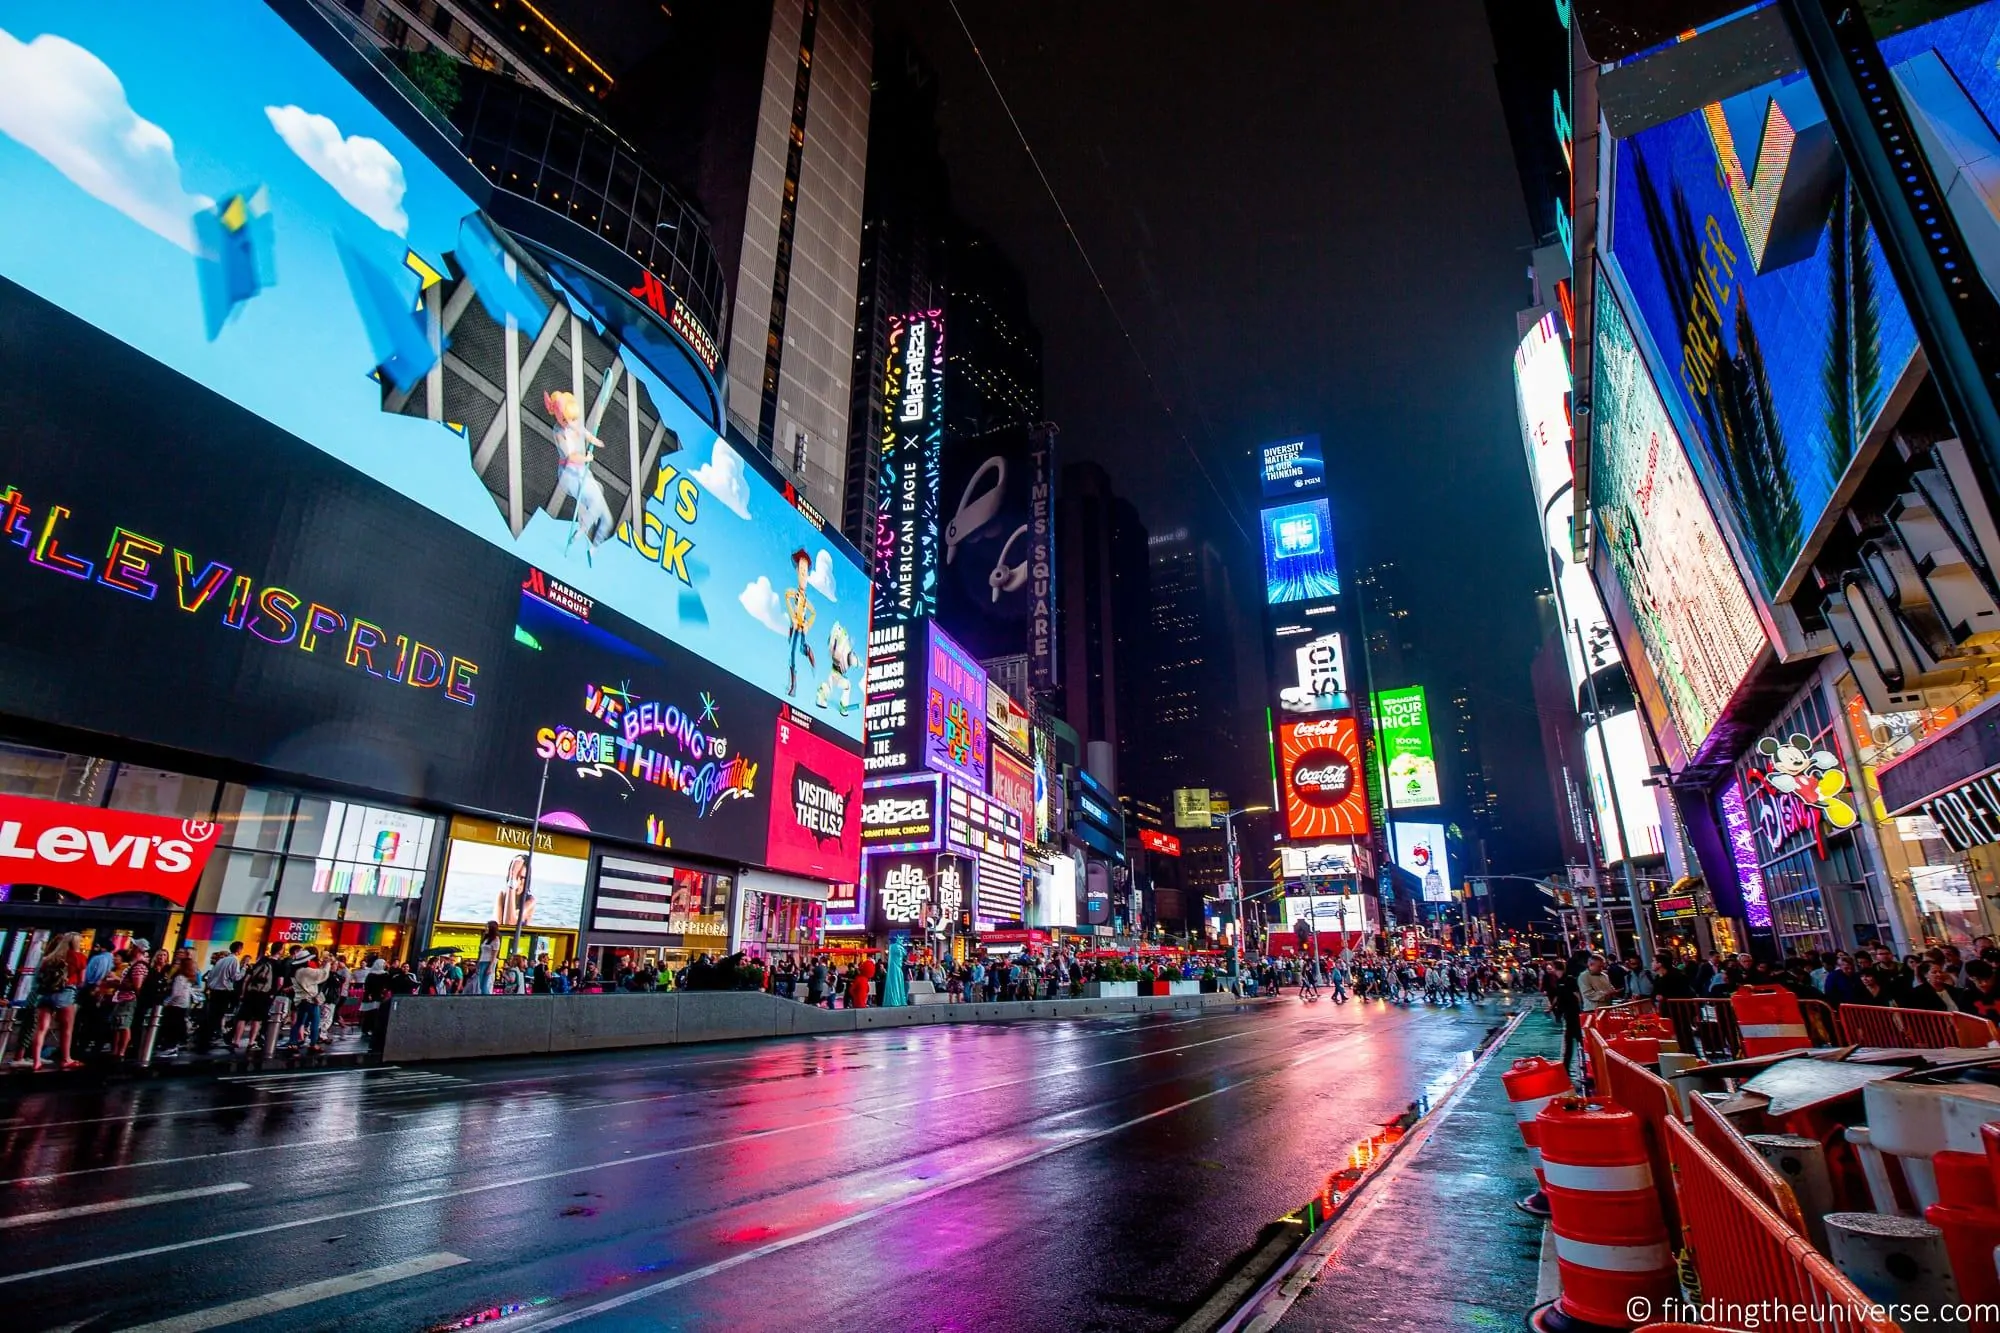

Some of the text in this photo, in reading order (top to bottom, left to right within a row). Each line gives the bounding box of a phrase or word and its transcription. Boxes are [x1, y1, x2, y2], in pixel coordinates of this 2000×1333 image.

[672, 315, 715, 371] MARQUIS
[674, 300, 720, 364] MARRIOTT
[1263, 442, 1304, 458] DIVERSITY
[1264, 451, 1300, 466] MATTERS
[1265, 461, 1293, 473] IN OUR
[1266, 467, 1304, 481] THINKING
[903, 461, 917, 511] EAGLE
[797, 505, 823, 533] MARQUIS
[798, 494, 826, 526] MARRIOTT
[899, 519, 914, 608] AMERICAN
[1031, 451, 1050, 656] TIMES SQUARE
[548, 591, 588, 618] MARQUIS
[550, 580, 595, 608] MARRIOTT
[1305, 605, 1337, 616] SAMSUNG
[584, 682, 623, 730] WE
[1384, 702, 1422, 715] YOUR
[623, 701, 727, 760] BELONG TO
[866, 715, 906, 731] ILØTS
[1293, 719, 1339, 738] Coca-Cola
[873, 740, 890, 756] THE
[1395, 737, 1422, 745] 100%
[536, 725, 698, 796] SOMETHING
[864, 754, 907, 770] TROKES
[695, 753, 759, 818] Beautiful
[1295, 765, 1348, 785] Coca-Cola
[1320, 782, 1345, 791] SUGAR
[797, 779, 843, 813] VISITING
[796, 802, 844, 837] THE U.S.?
[288, 922, 323, 937] PROUD
[671, 919, 728, 936] SEPHORA
